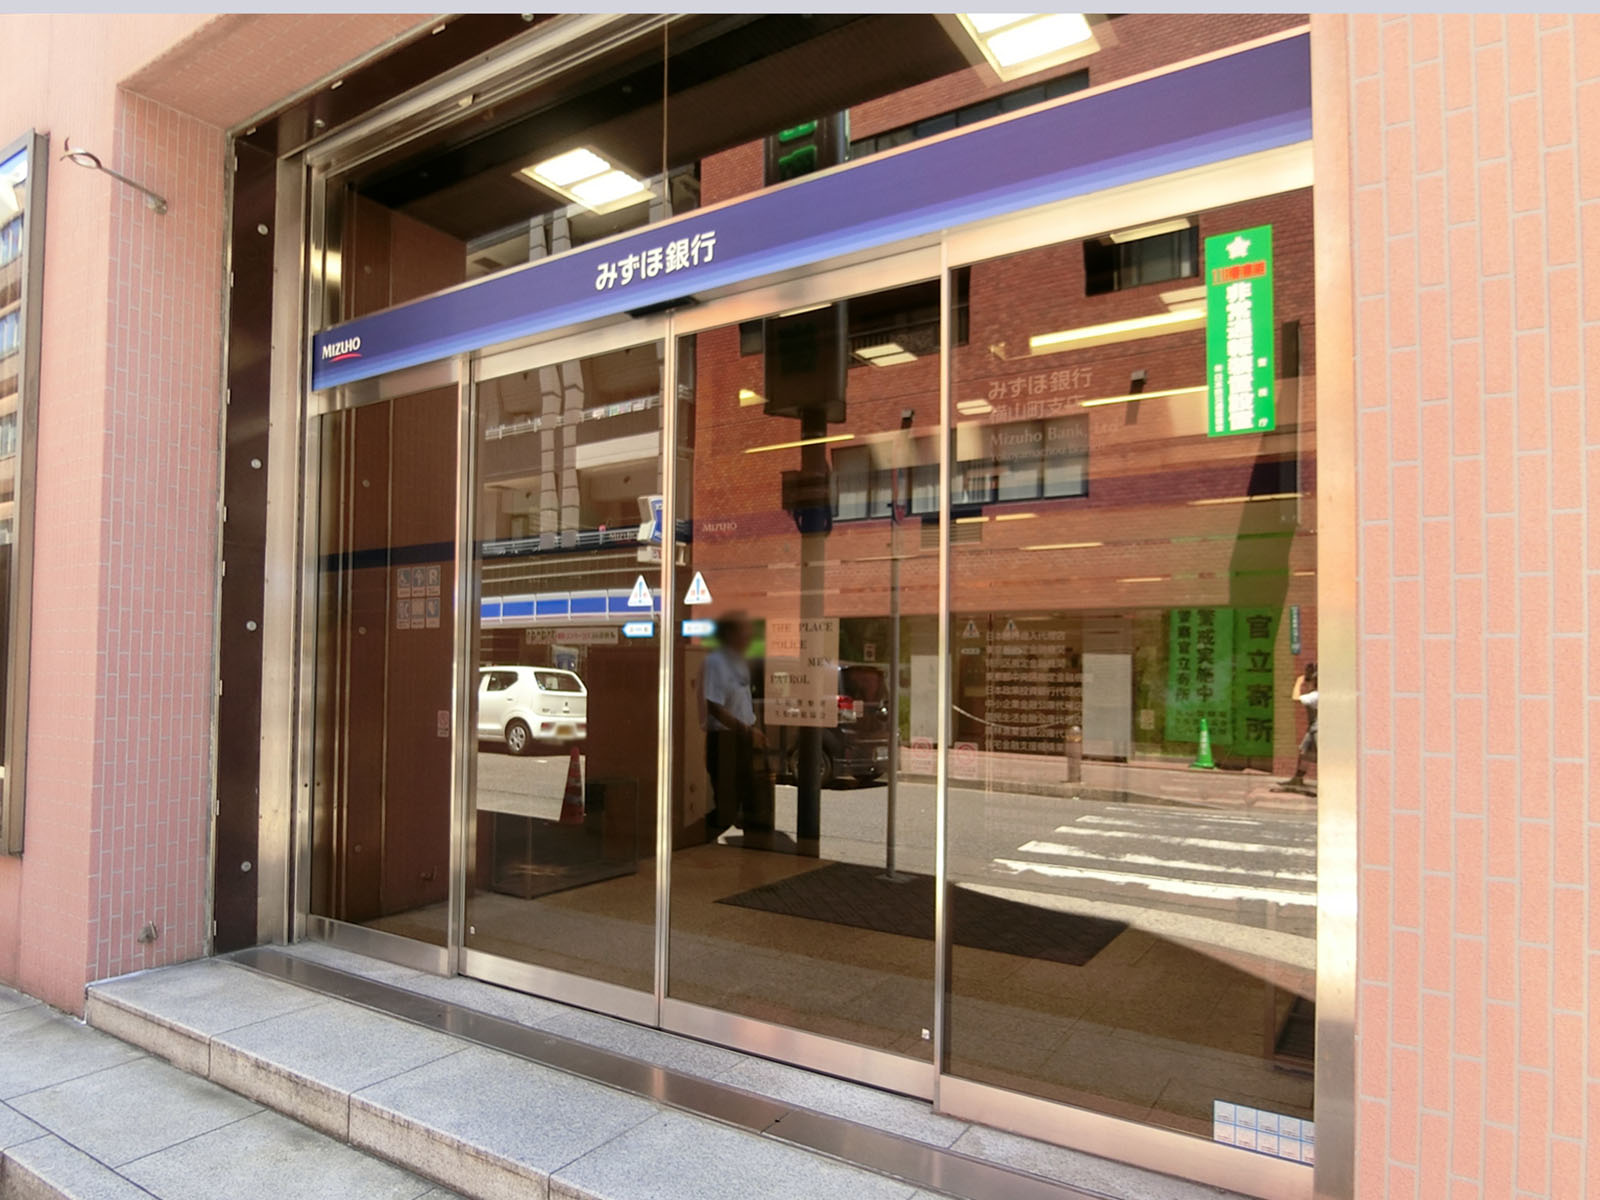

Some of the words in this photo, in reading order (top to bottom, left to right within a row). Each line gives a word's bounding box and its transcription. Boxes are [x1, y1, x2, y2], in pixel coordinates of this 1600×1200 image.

[595, 230, 717, 291] みずほ銀行
[321, 336, 361, 360] MIZUHO
[988, 367, 1093, 400] みずほ銀行
[990, 428, 1043, 446] Mizuho
[799, 621, 834, 634] PLACE
[771, 639, 808, 650] POLICE
[807, 656, 833, 668] MEN
[770, 674, 811, 685] PATROL
